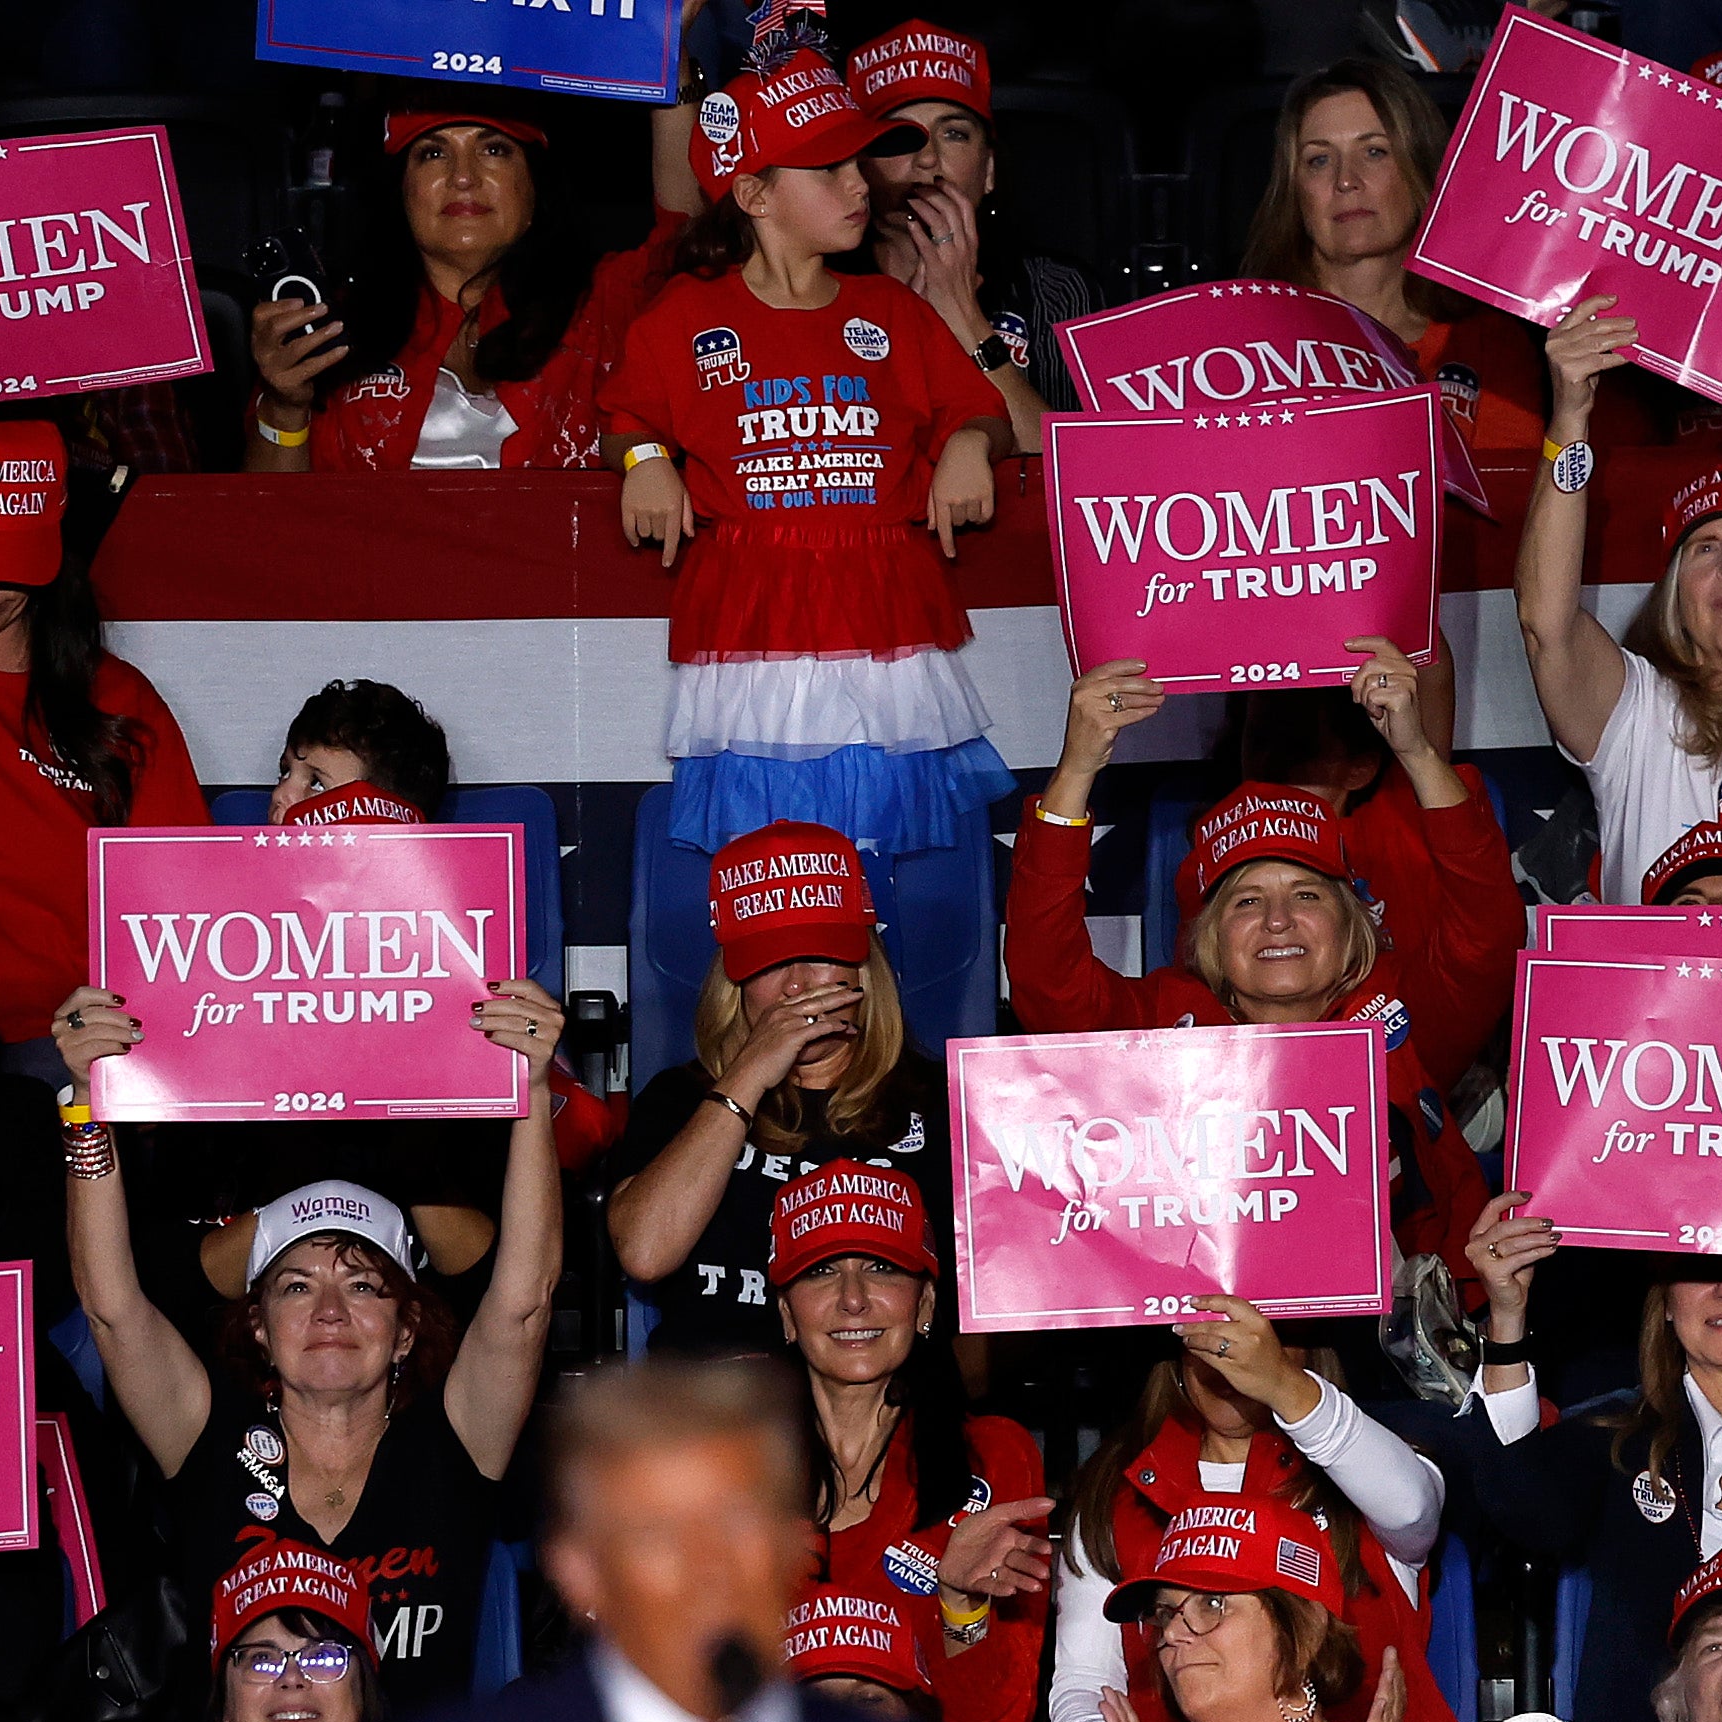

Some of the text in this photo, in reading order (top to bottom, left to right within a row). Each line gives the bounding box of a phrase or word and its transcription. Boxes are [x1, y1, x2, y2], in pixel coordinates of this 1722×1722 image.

[433, 52, 501, 74] 2024
[701, 109, 737, 126] TRUMP
[704, 100, 736, 114] TEAM
[707, 129, 727, 140] 2024
[1505, 190, 1568, 225] for
[697, 353, 738, 371] TRUMP
[744, 376, 870, 408] KIDS FOR
[738, 407, 880, 446] TRUMP
[736, 453, 884, 475] MAKE AMERICA
[745, 473, 876, 492] GREAT AGAIN
[746, 489, 877, 510] FOR OUR FUTURE
[1074, 471, 1419, 564] WOMEN
[1137, 558, 1376, 616] for TRUMP
[1231, 663, 1300, 682] 2024
[121, 910, 493, 983] WOMEN
[184, 991, 432, 1036] for TRUMP
[274, 1093, 345, 1111] 2024
[983, 1100, 1355, 1196] WOMEN
[1593, 1121, 1654, 1162] for
[291, 1196, 371, 1218] Women
[301, 1209, 364, 1223] FOR TRUMP
[1050, 1189, 1299, 1244] for TRUMP
[1144, 1296, 1196, 1315] 202
[237, 1447, 284, 1500] #MAGA
[249, 1497, 277, 1511] TIPS
[903, 1554, 934, 1576] 2024
[887, 1563, 936, 1595] VANCE
